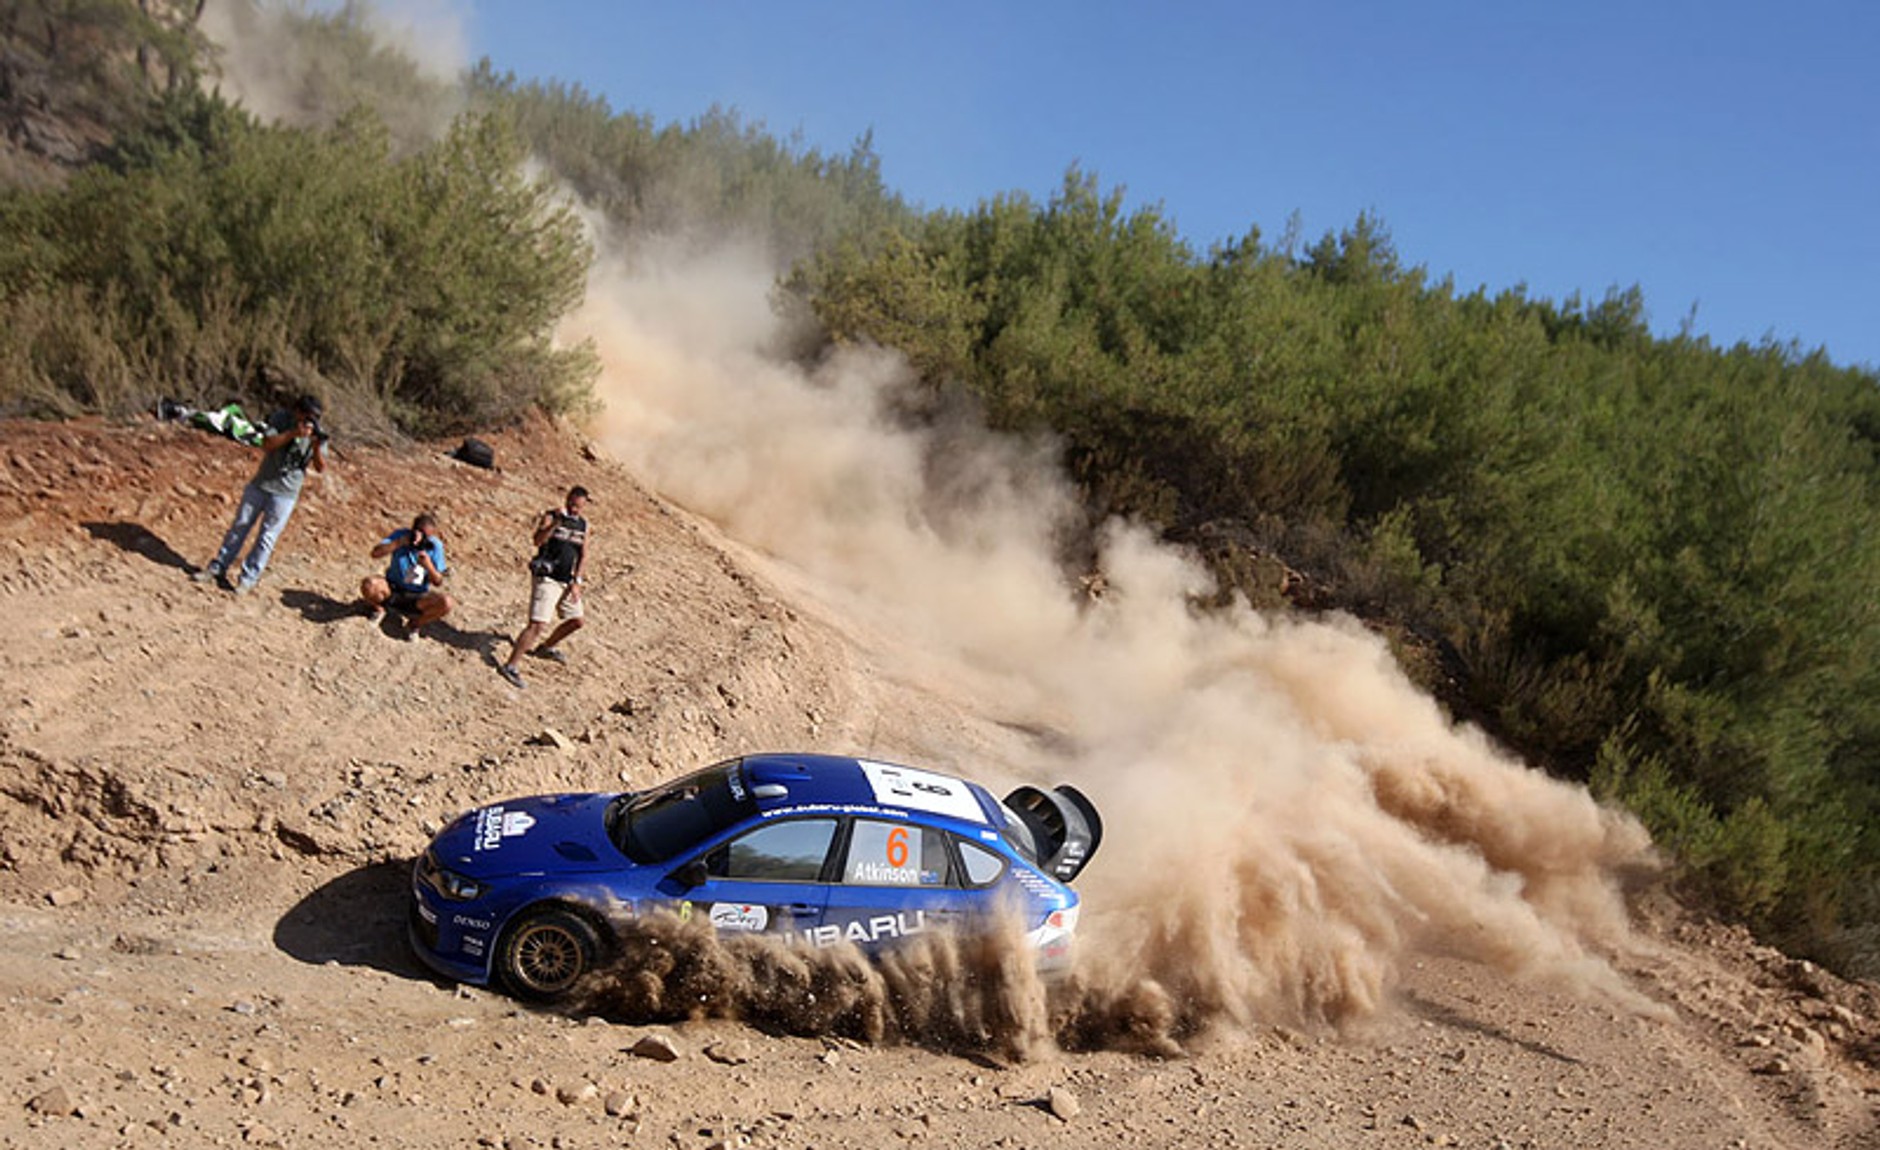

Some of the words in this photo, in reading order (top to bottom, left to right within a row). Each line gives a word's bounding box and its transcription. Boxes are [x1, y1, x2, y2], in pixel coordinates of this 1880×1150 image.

[886, 827, 909, 868] 6
[855, 862, 918, 883] Atkinson
[783, 909, 925, 950] UBARU
